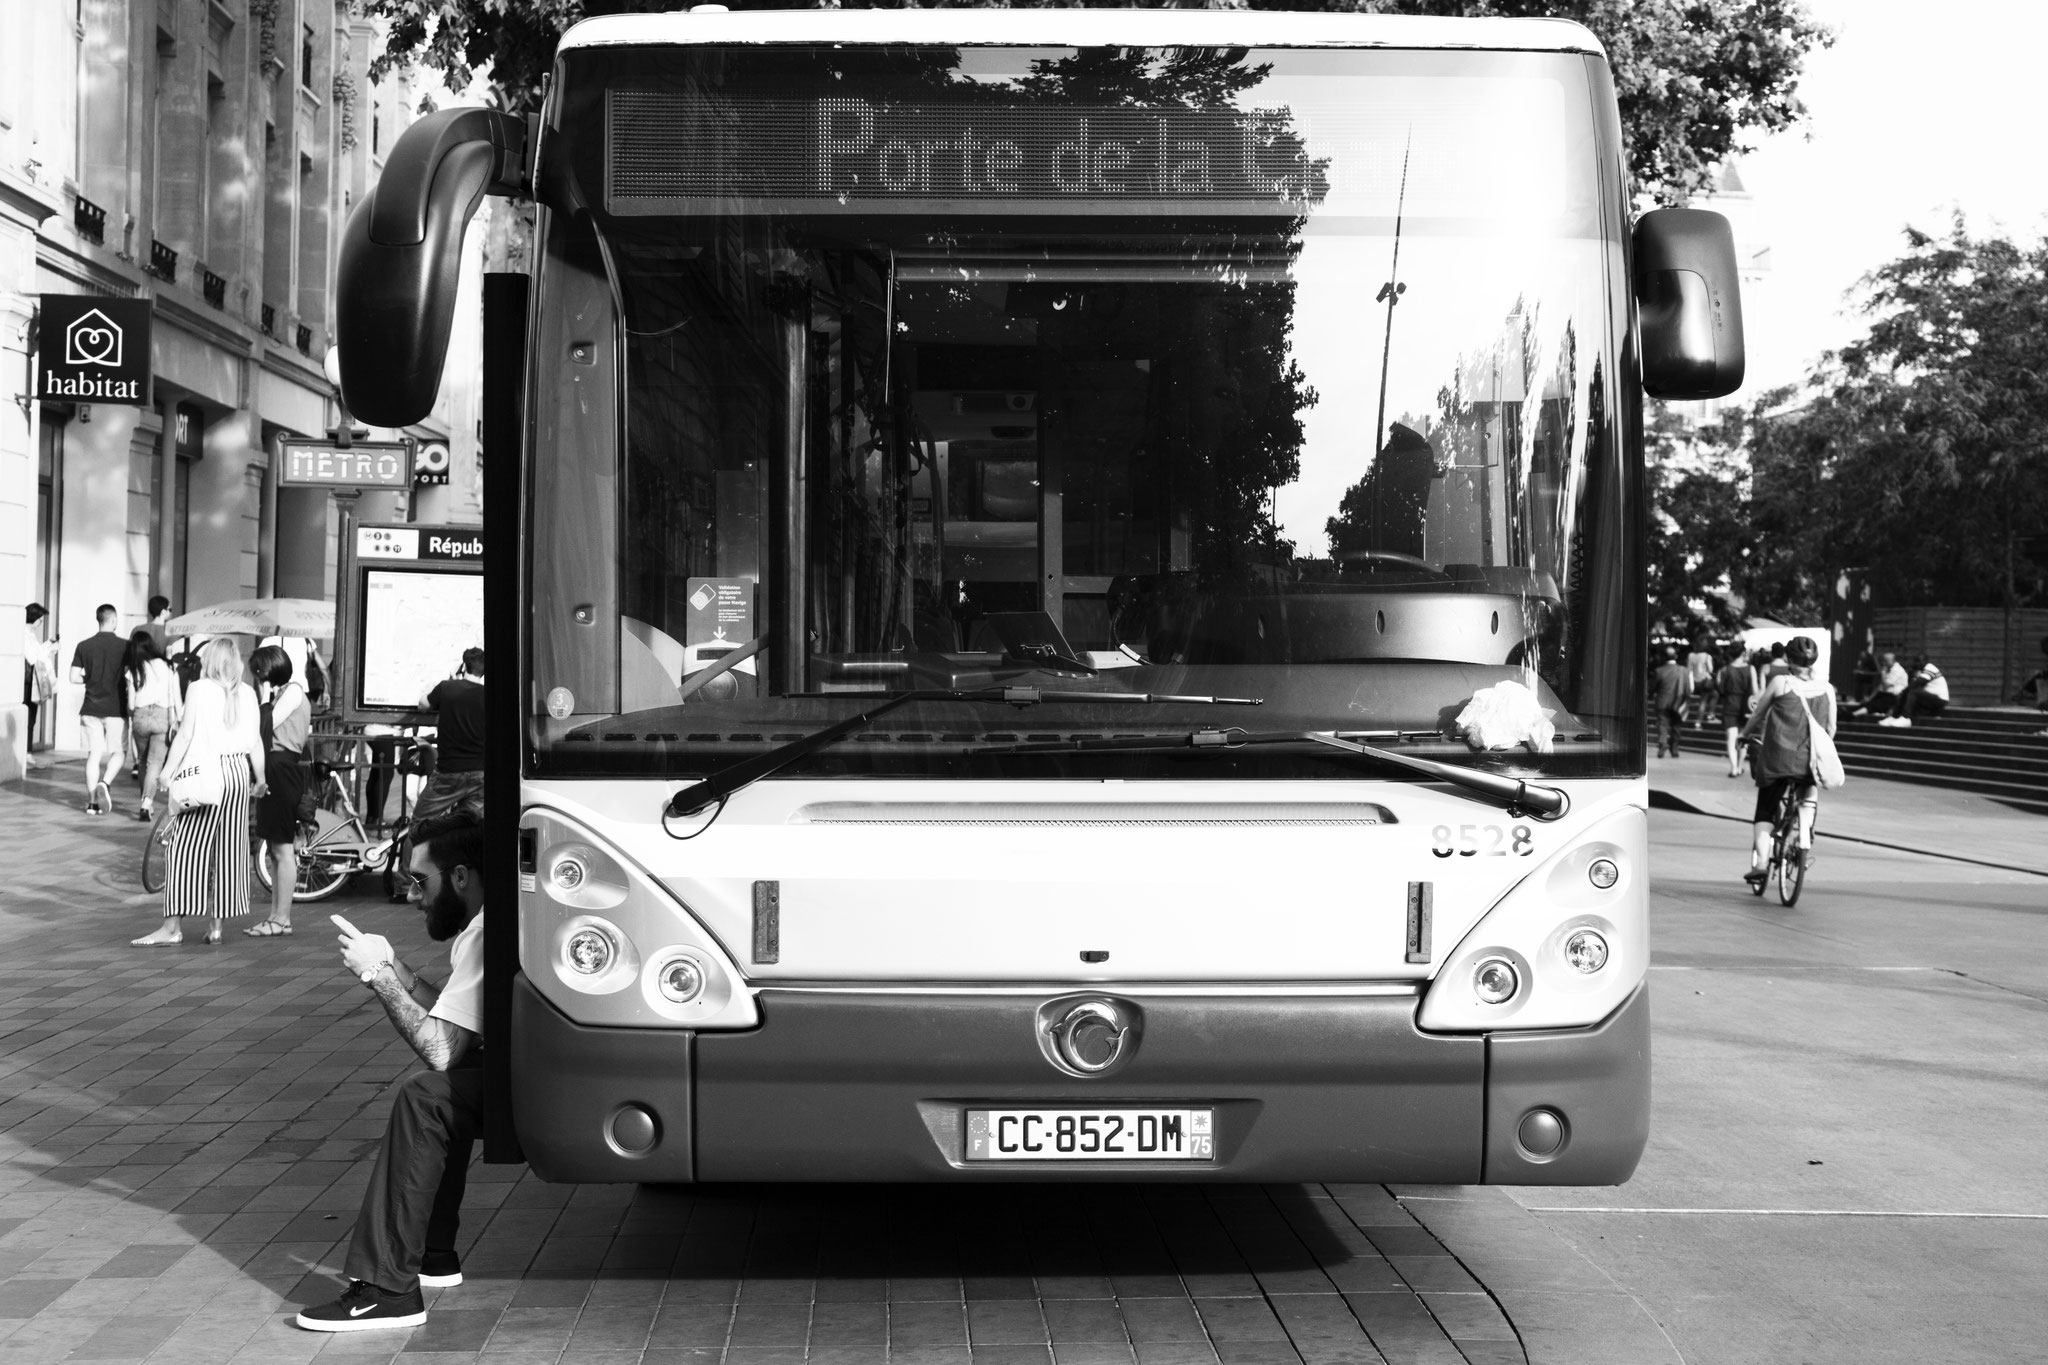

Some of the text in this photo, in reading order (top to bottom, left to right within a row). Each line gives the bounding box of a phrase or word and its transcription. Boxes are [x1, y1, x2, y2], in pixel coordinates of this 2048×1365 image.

[818, 97, 1023, 192] Porte
[1052, 117, 1131, 192] de
[1158, 117, 1214, 192] la
[46, 369, 140, 399] habitat
[292, 450, 399, 480] METRO
[1431, 824, 1535, 859] 8528
[974, 1114, 1211, 1154] F CC-852-DM 75
